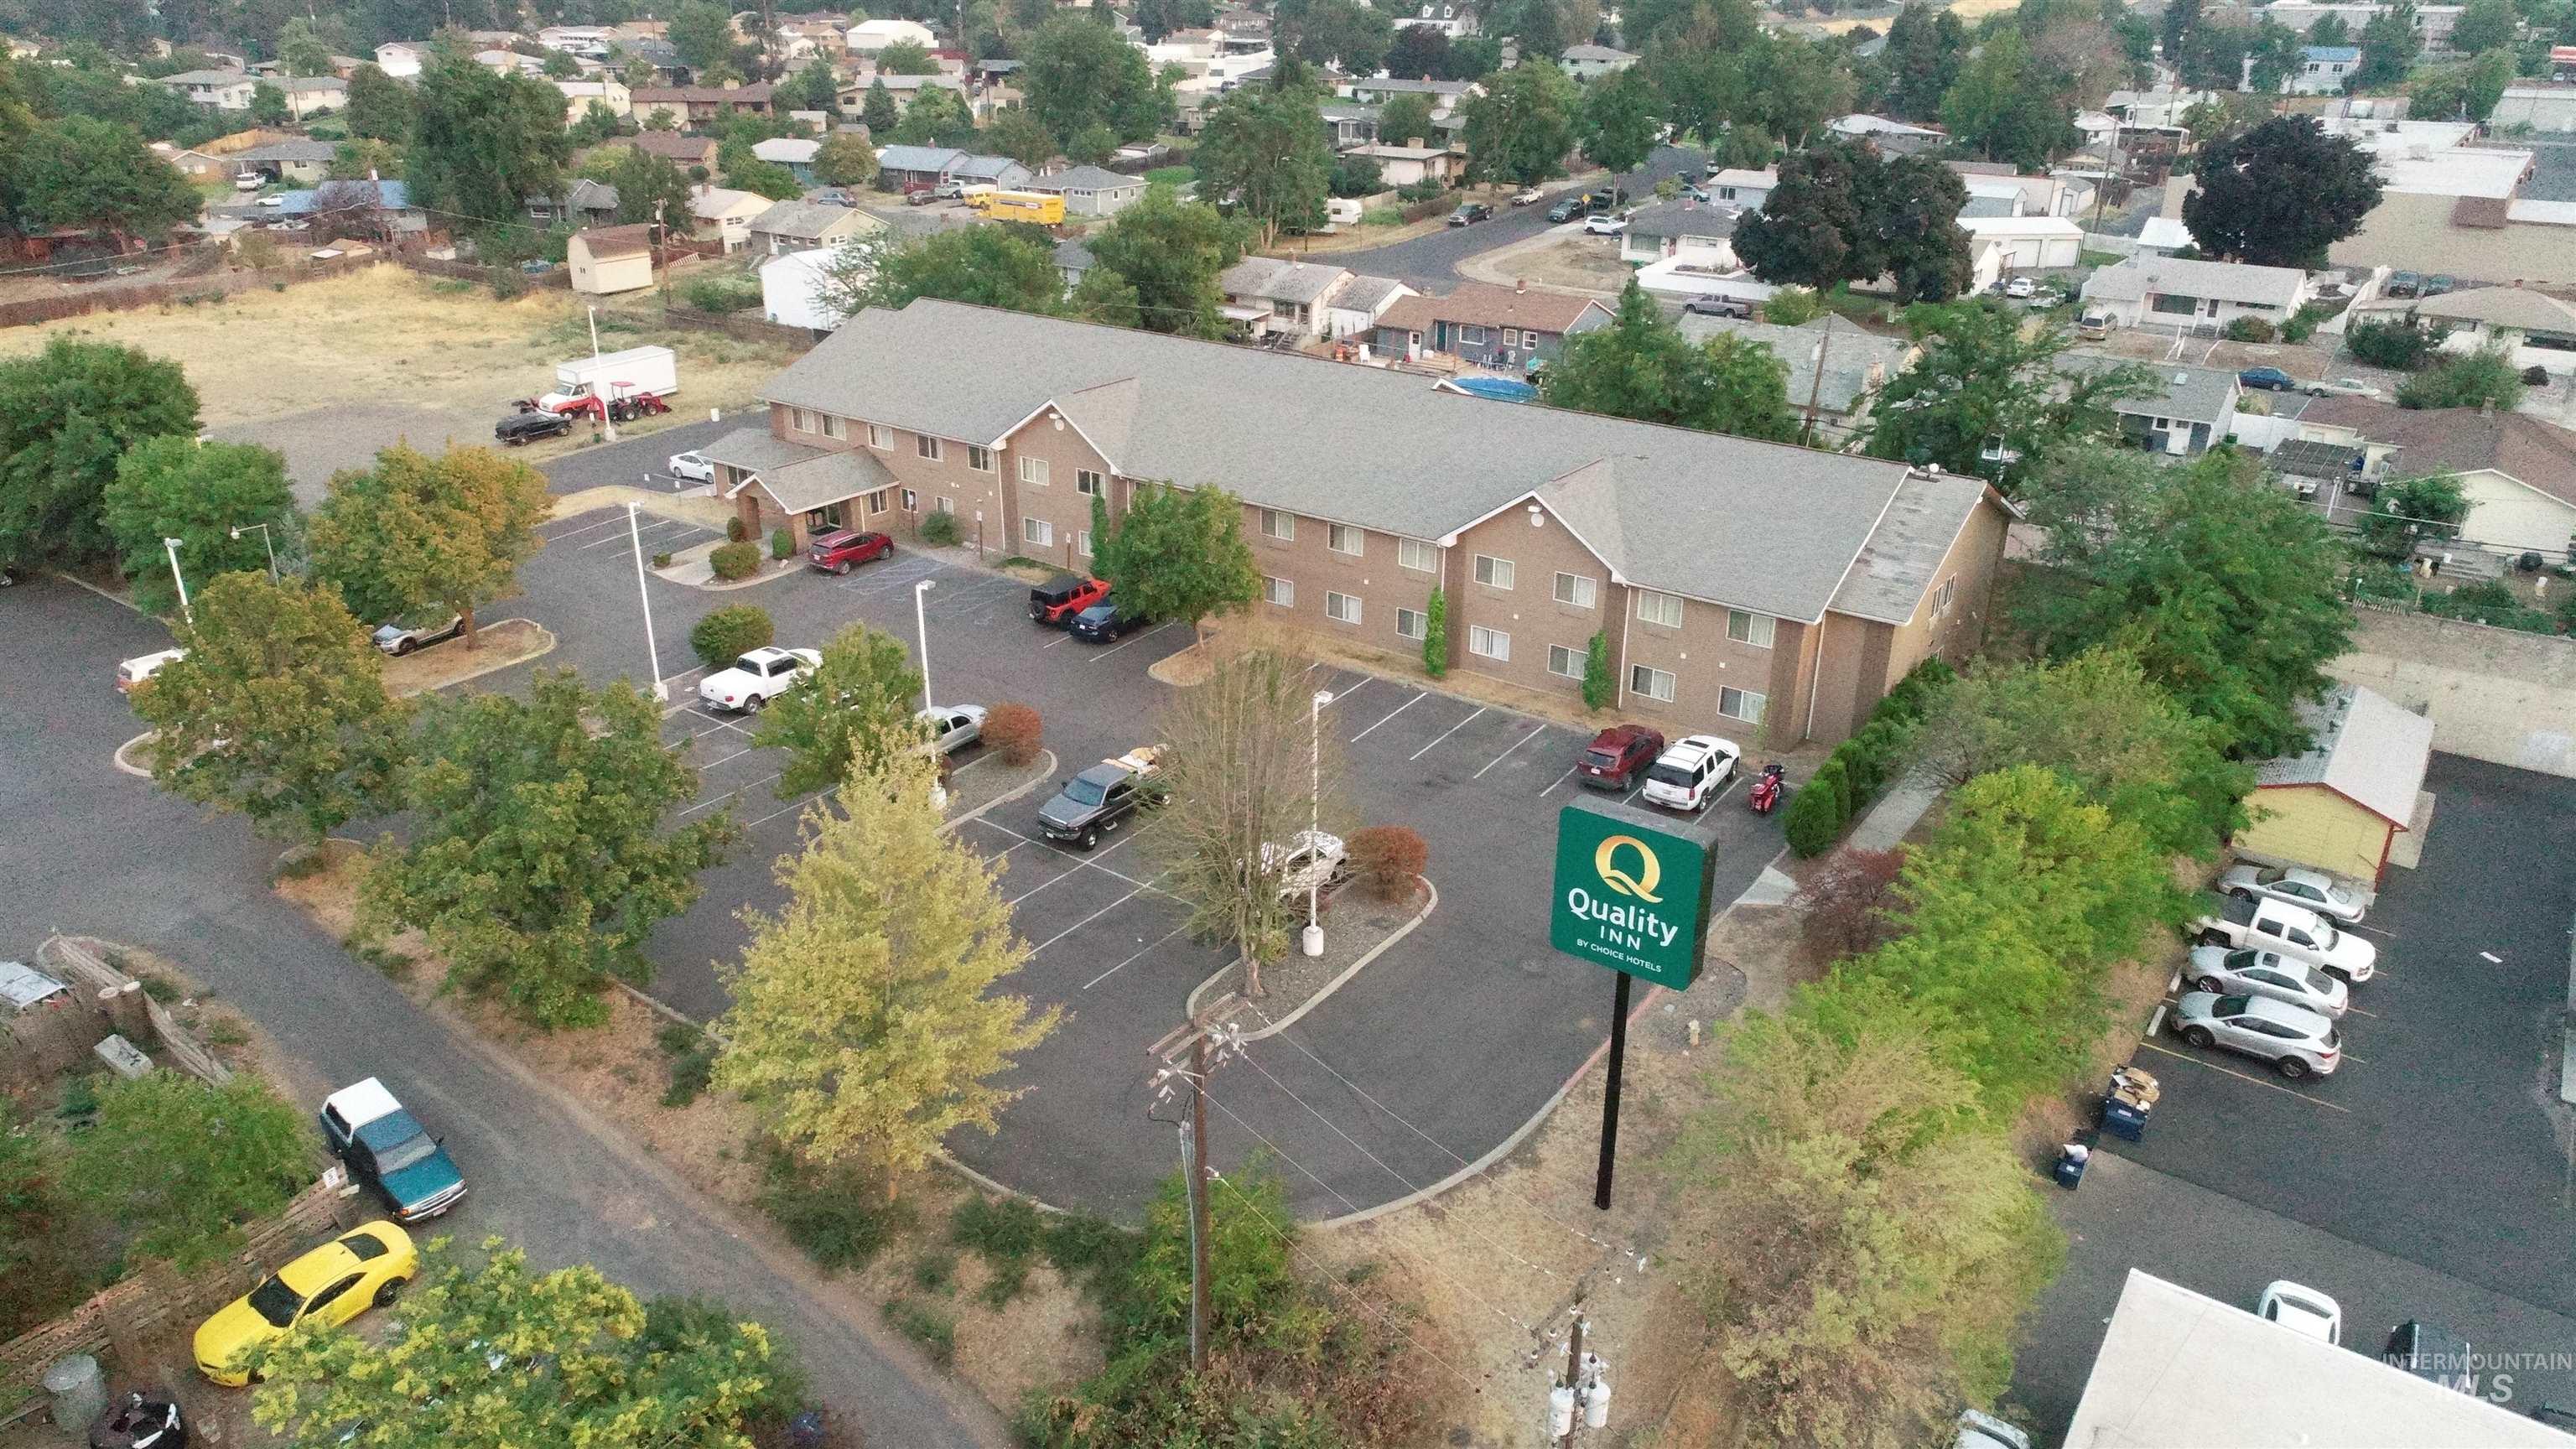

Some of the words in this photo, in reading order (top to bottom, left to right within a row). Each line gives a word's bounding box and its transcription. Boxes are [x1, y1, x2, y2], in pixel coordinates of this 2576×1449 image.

[1595, 834, 1664, 903] Q
[1568, 887, 1679, 947] Quality
[1600, 925, 1641, 951] INN
[1576, 938, 1589, 948] BY
[1591, 943, 1624, 961] CHOICE
[1626, 955, 1663, 973] HOTELS
